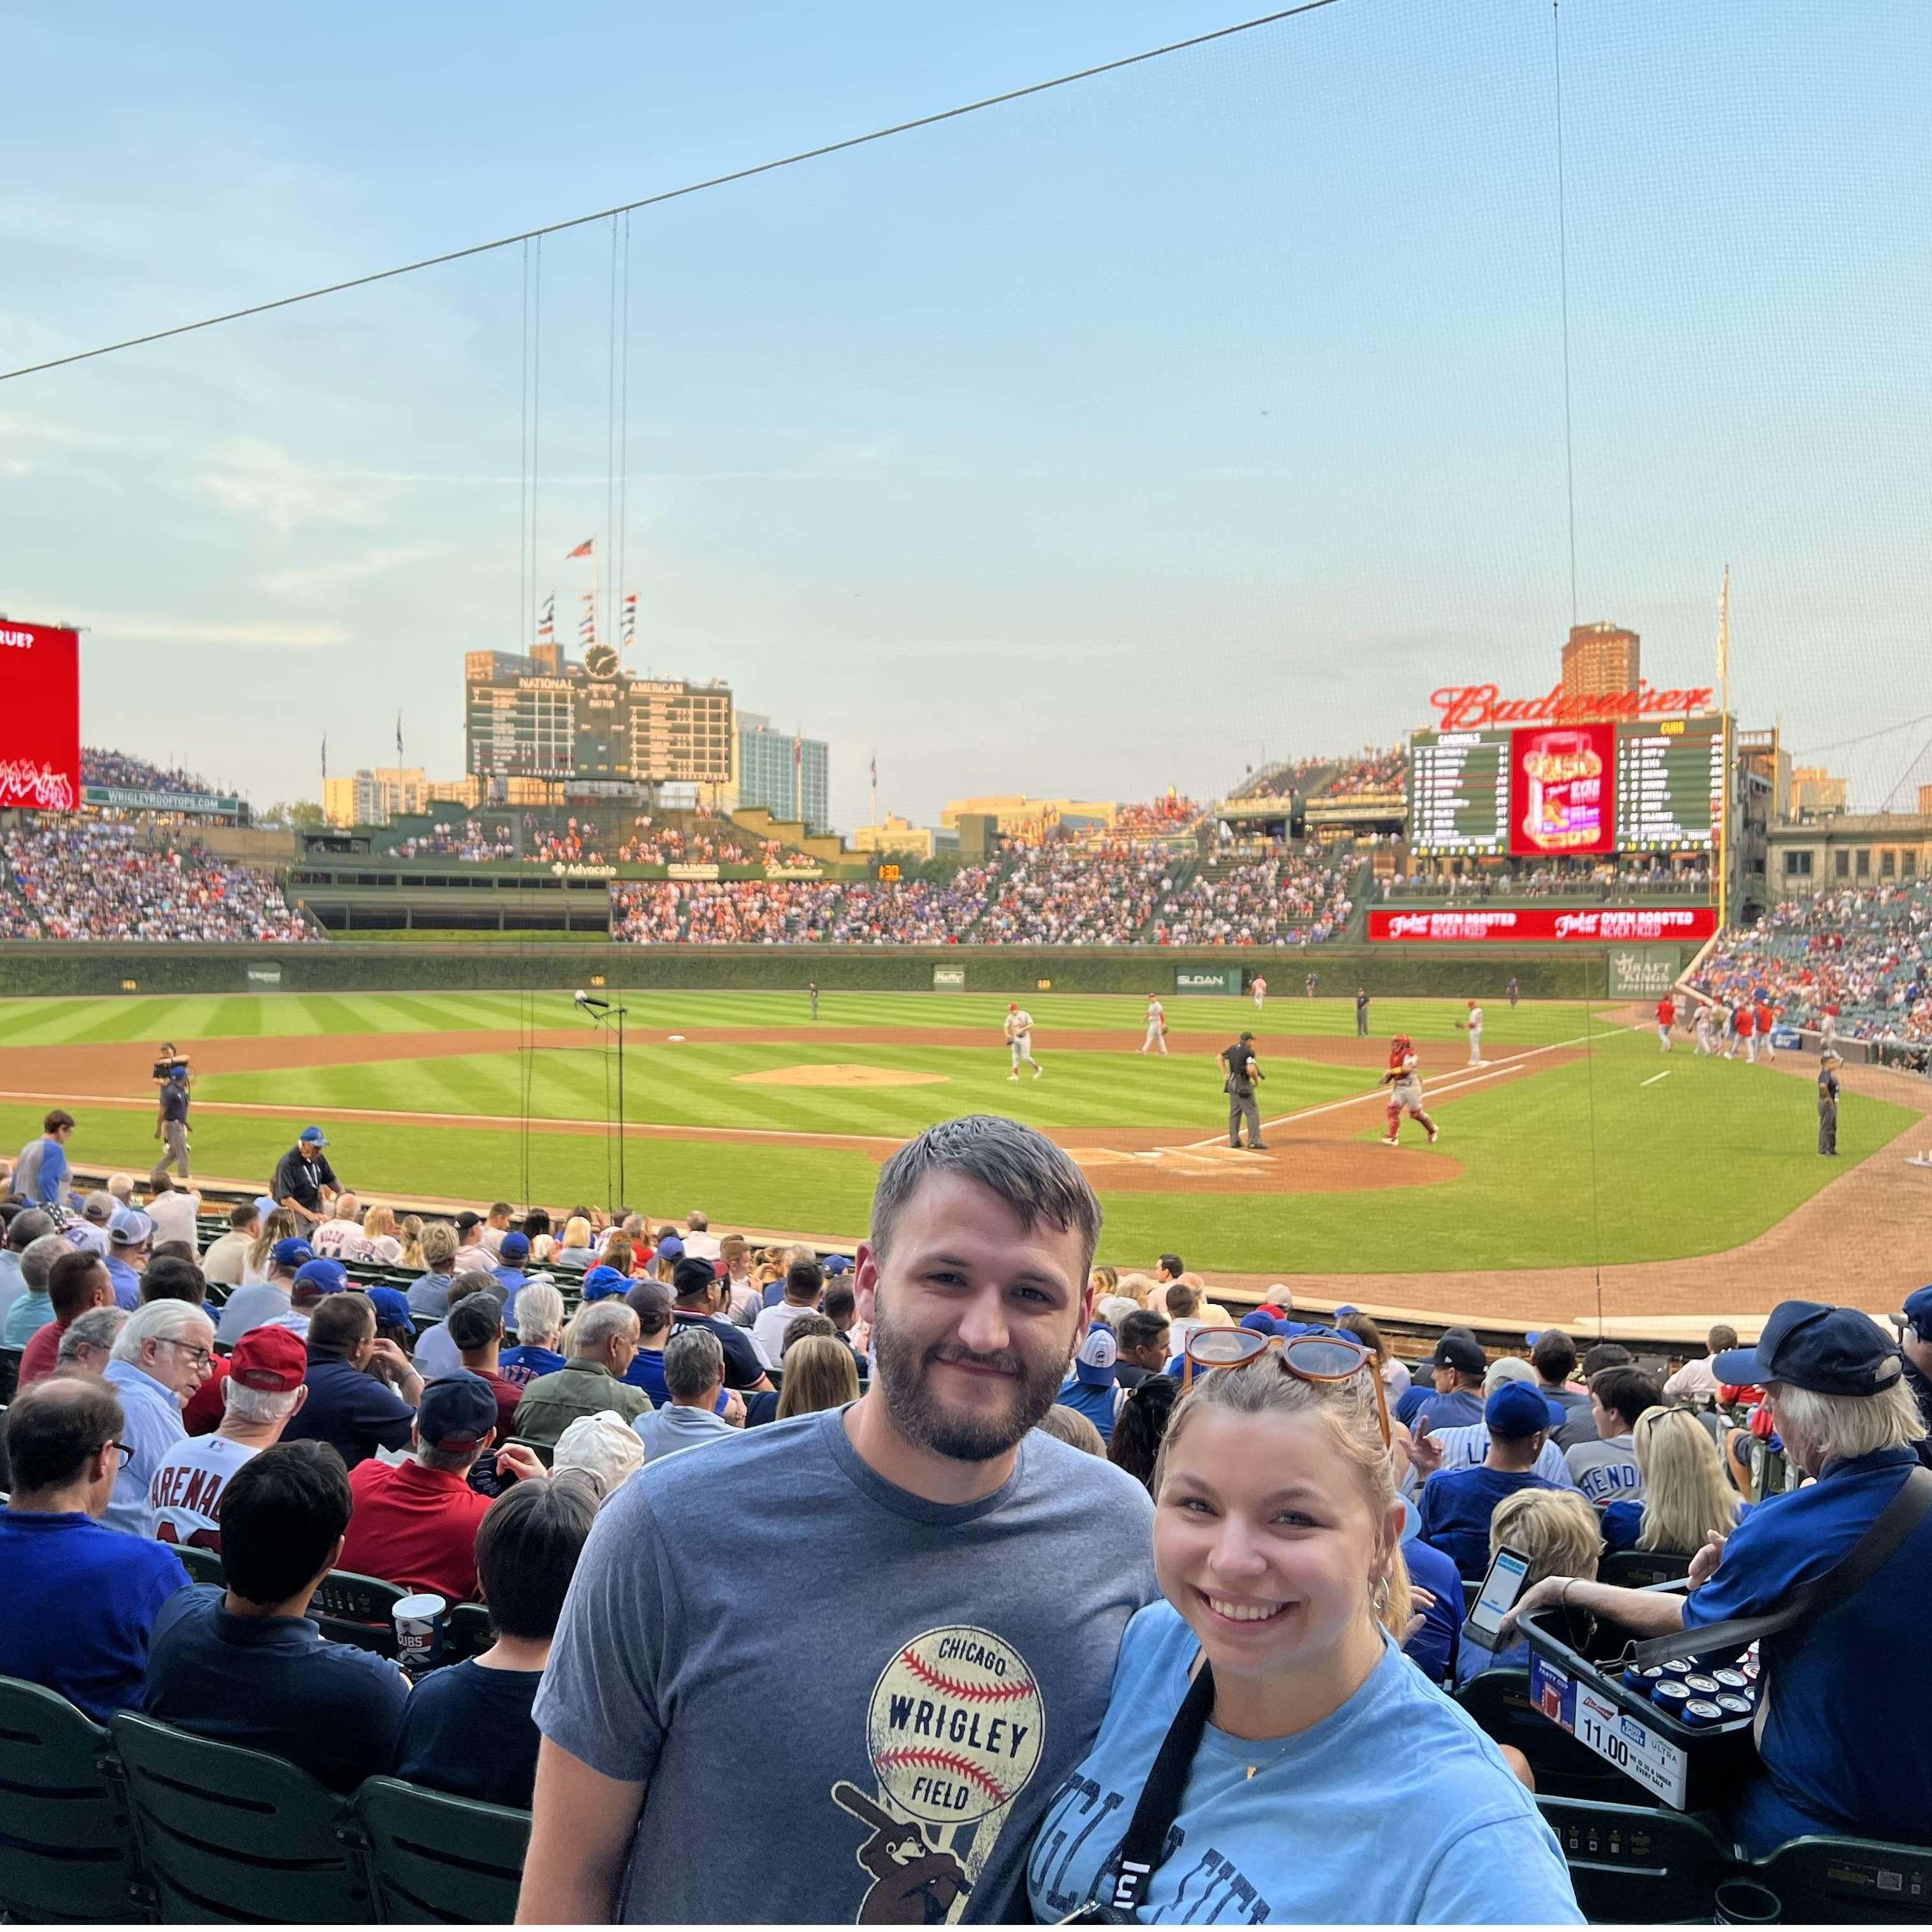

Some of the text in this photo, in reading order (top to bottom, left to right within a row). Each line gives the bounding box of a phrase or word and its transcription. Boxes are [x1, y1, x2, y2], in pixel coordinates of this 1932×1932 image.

[519, 678, 575, 689] NATIONAL
[630, 682, 684, 694] AMERICAN
[1430, 678, 1713, 730] Budweiser
[1660, 721, 1685, 735] CUBS
[1438, 733, 1481, 745] CARDINALS
[567, 863, 617, 875] Advocate
[1431, 913, 1464, 925] OVEN
[1465, 913, 1517, 926] ROASTED
[1600, 912, 1636, 924] OVEN
[1637, 911, 1694, 925] ROASTED
[1600, 925, 1631, 937] NEVER
[1177, 976, 1224, 985] SLOAN
[1624, 972, 1669, 983] KINGS
[1581, 1463, 1642, 1498] HEND
[397, 1634, 422, 1647] CUBS
[939, 1638, 1006, 1676] CHICAGO
[1539, 1666, 1569, 1689] PARTY CUP
[889, 1694, 1028, 1758] WRIGLEY
[1625, 1720, 1642, 1736] BUD
[1584, 1718, 1628, 1766] 11.00
[1623, 1725, 1644, 1746] LIGHT
[1651, 1741, 1678, 1762] ULTRA
[1629, 1753, 1637, 1763] WE
[1656, 1769, 1672, 1787] UNDER
[1636, 1765, 1664, 1789] EVERY SALE
[912, 1777, 969, 1810] FIELD
